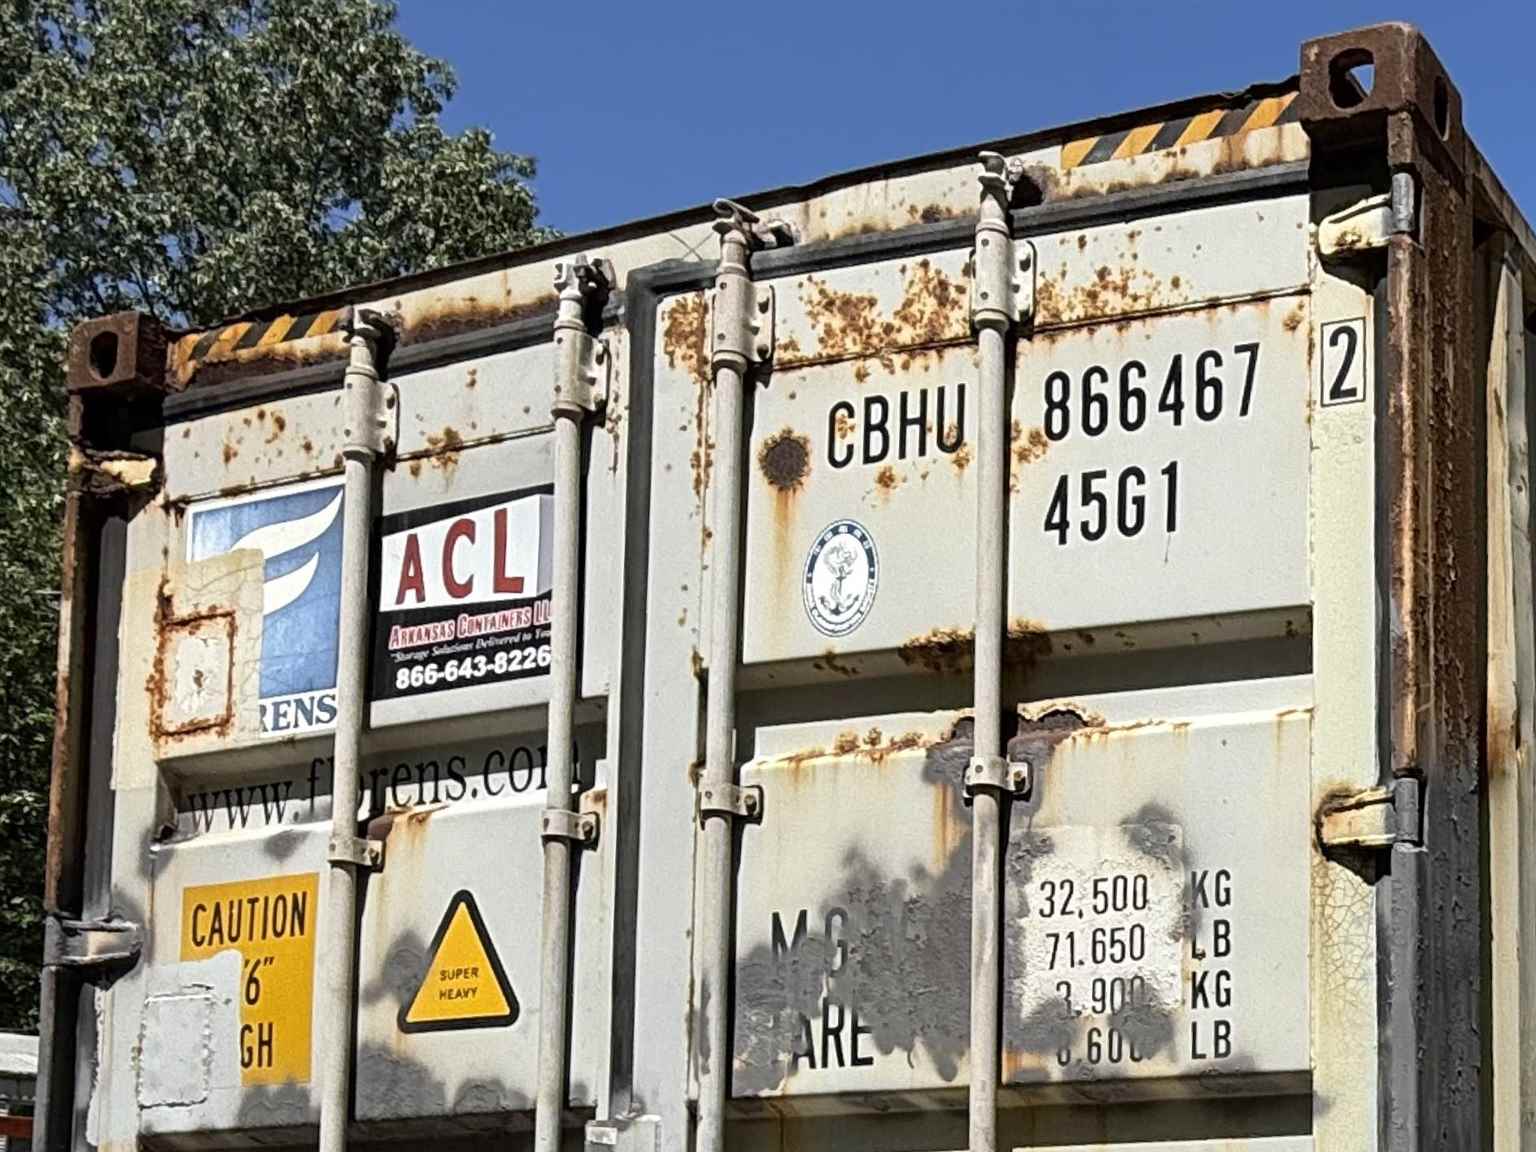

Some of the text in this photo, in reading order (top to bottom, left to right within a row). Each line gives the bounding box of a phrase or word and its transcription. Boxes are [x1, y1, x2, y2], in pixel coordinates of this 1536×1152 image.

[1328, 324, 1360, 400] 2
[826, 341, 1261, 470] CBHU 866467
[1043, 460, 1180, 545] 45G1
[395, 508, 526, 606] ACL
[388, 599, 551, 650] ARKANSAS CONTAINERS LL
[395, 644, 551, 689] 866-643-8226
[259, 694, 337, 732] RENS
[1039, 869, 1231, 919] 32,500 KG
[192, 891, 307, 947] CAUTION
[1190, 919, 1231, 960] LB
[439, 986, 478, 1001] HEAVY
[440, 967, 479, 981] SUPER
[1190, 970, 1232, 1009] KG
[240, 1022, 273, 1069] GH
[791, 996, 874, 1069] ARE
[1190, 1020, 1232, 1060] LB
